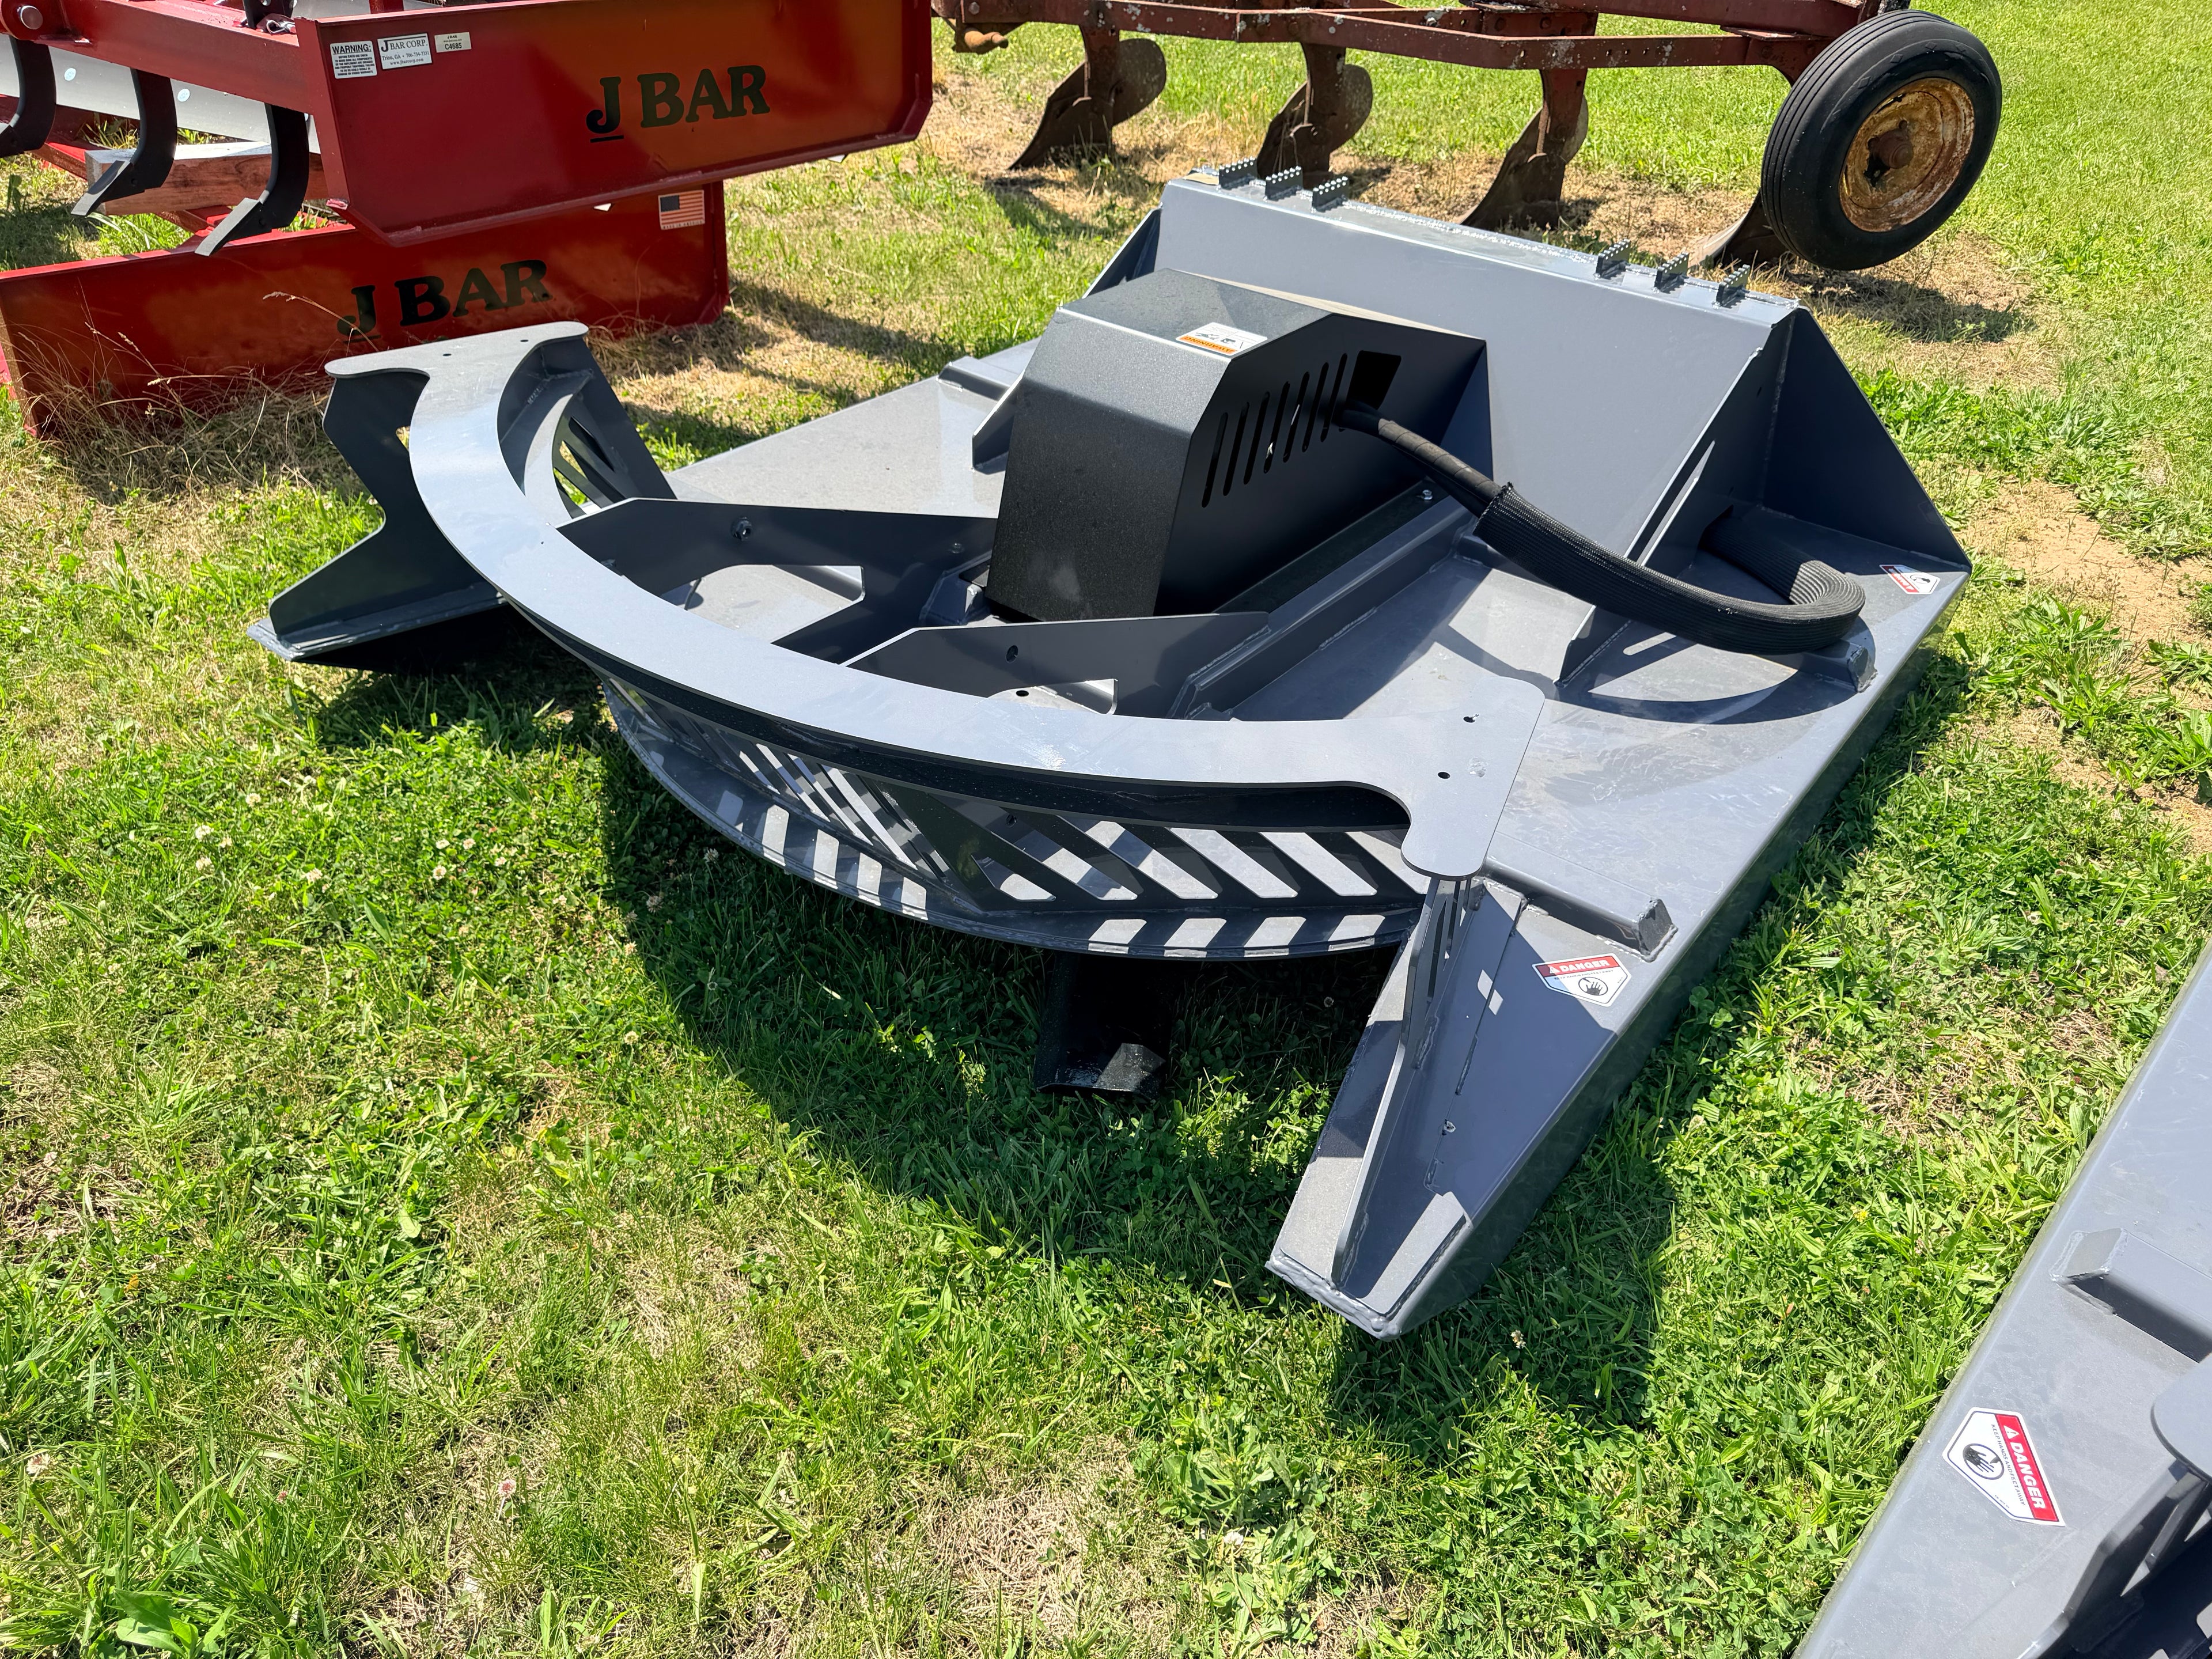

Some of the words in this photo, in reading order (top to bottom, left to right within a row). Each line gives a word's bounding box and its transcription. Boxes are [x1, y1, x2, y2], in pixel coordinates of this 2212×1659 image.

[332, 44, 372, 54] WARNING:
[381, 40, 389, 52] J
[389, 41, 406, 50] BAR
[406, 39, 428, 48] CORP.
[586, 76, 622, 134] J
[637, 65, 771, 128] BAR
[337, 285, 376, 336] J
[394, 259, 553, 326] BAR
[1559, 960, 1609, 972] DANGER
[1991, 1424, 2001, 1440] KEEP
[1997, 1440, 2008, 1460] HANDS
[2004, 1460, 2013, 1473] AND
[2009, 1472, 2019, 1488] FEET
[2015, 1488, 2026, 1506] AWAY
[2009, 1441, 2047, 1509] DANGER
